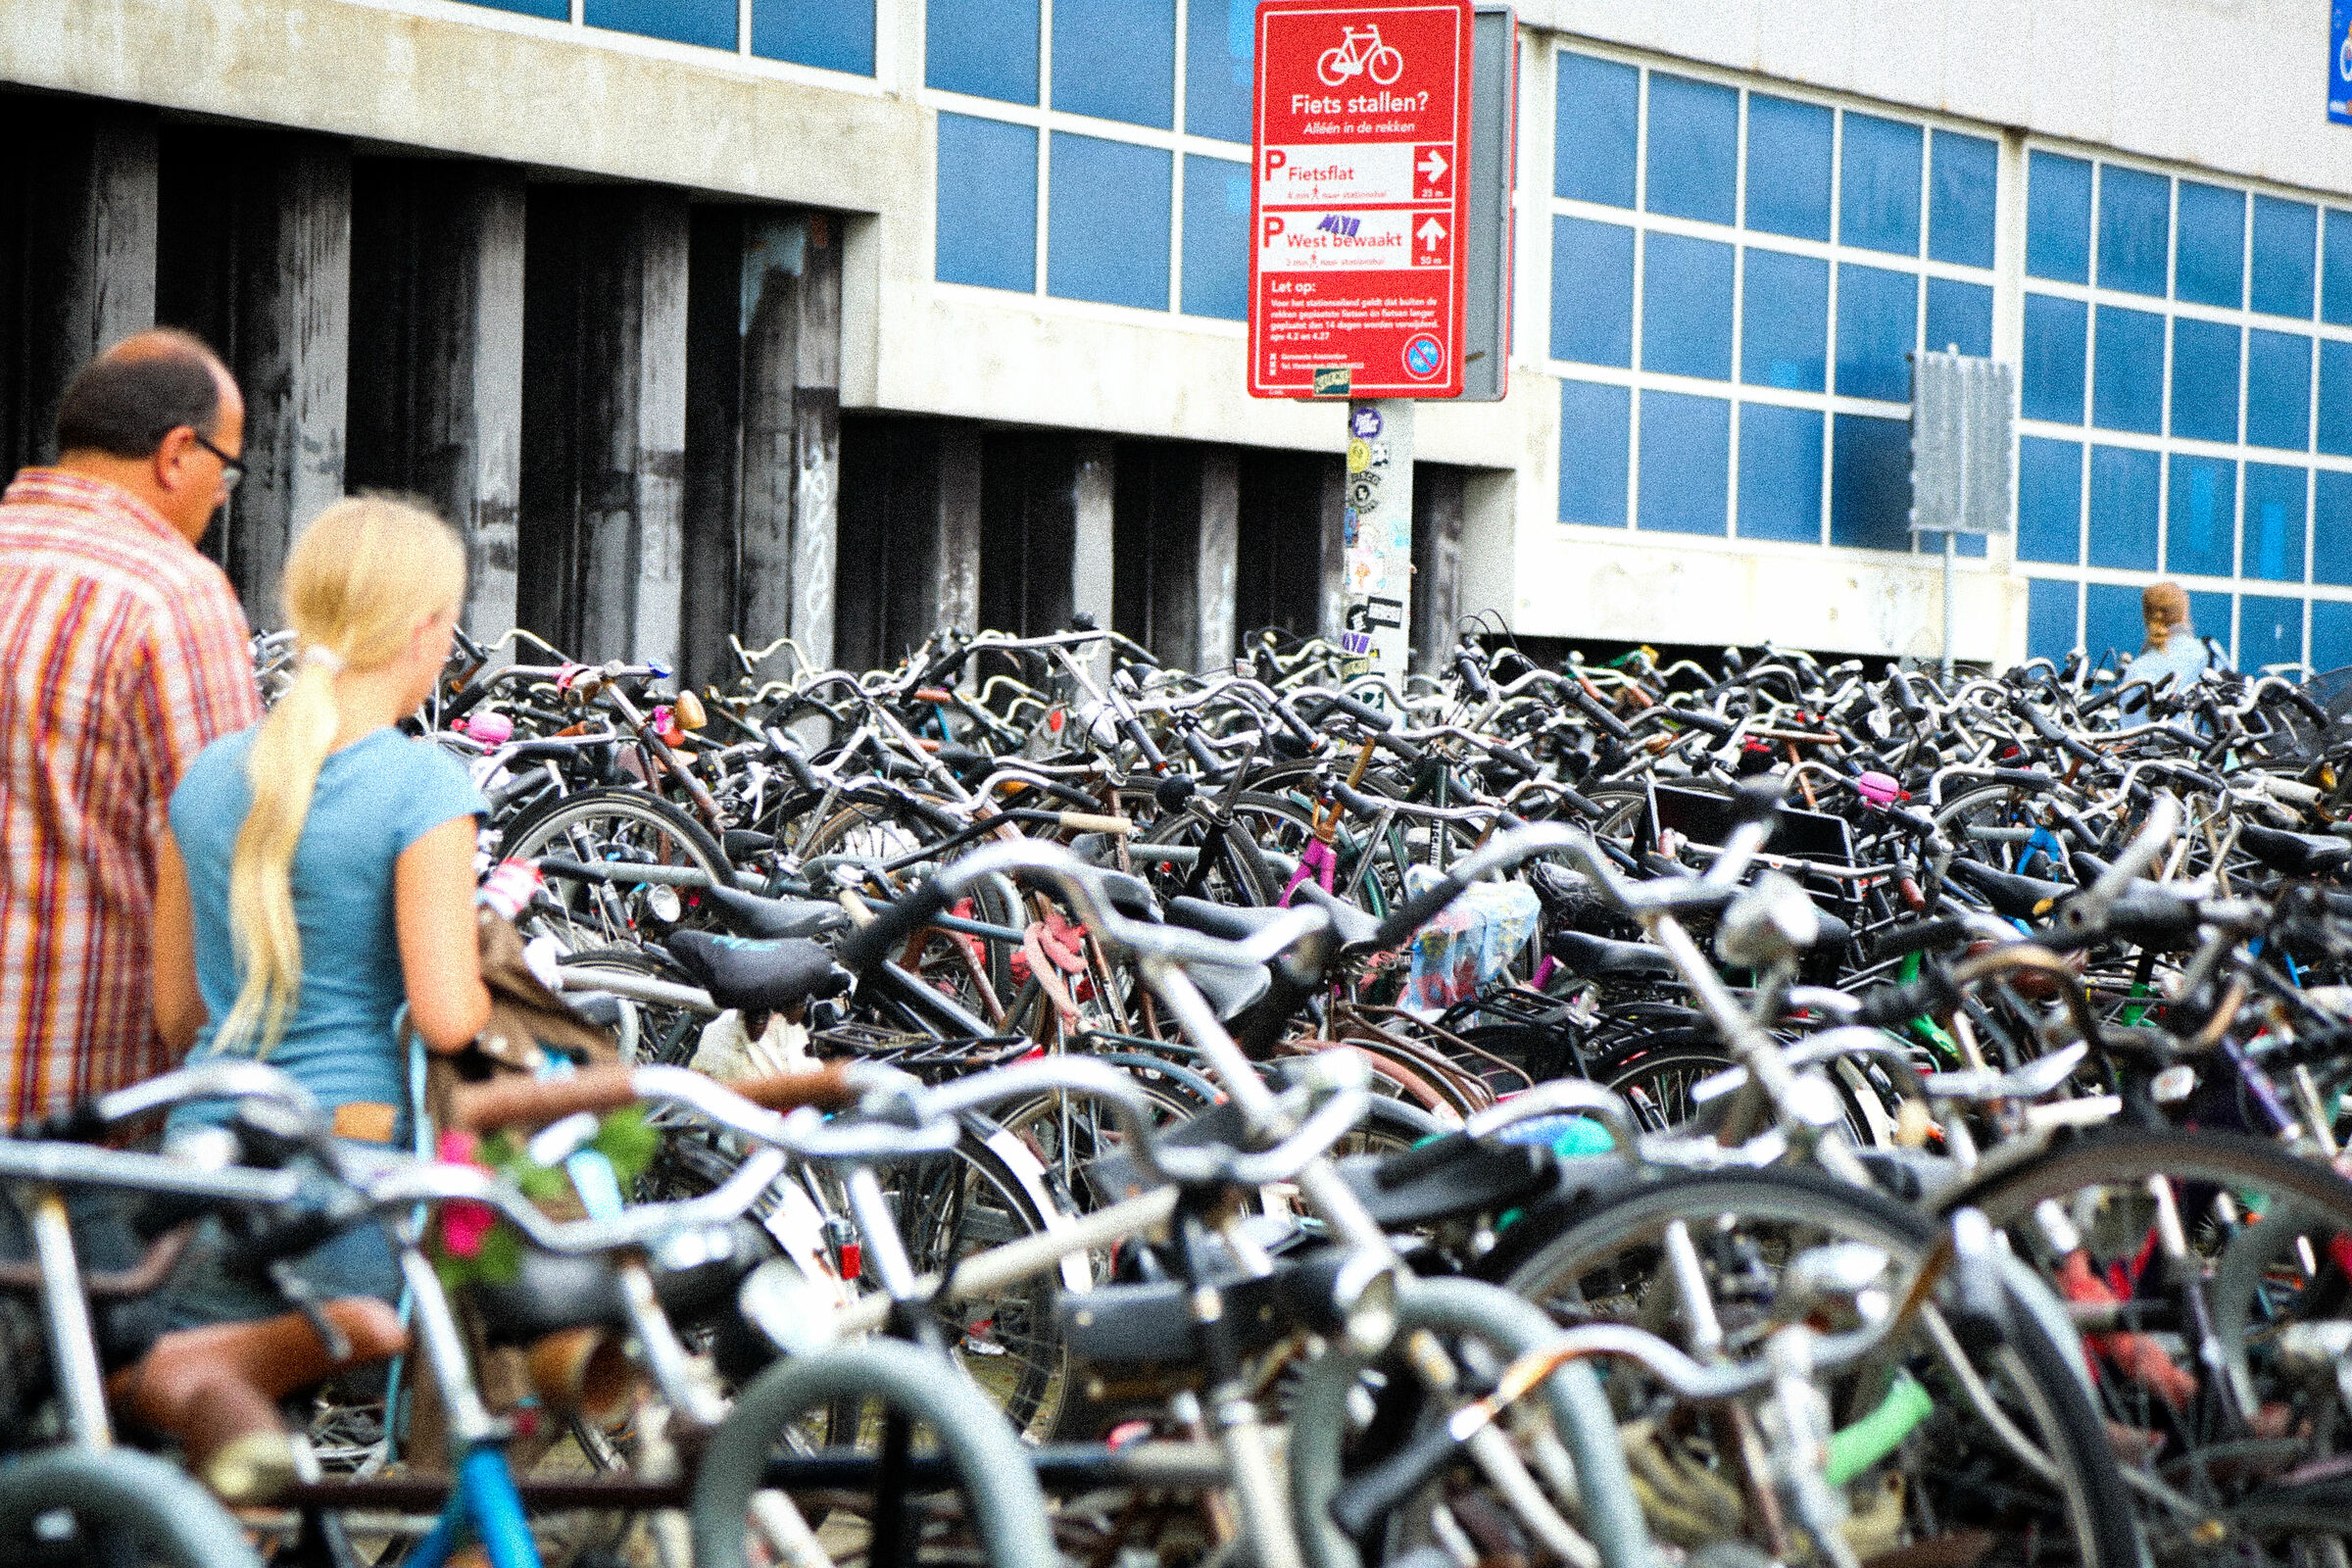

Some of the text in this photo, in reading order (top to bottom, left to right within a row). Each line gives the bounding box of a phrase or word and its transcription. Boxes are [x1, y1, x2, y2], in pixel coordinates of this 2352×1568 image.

[1291, 91, 1429, 115] Fiets stallen?
[1344, 122, 1354, 133] in
[1356, 121, 1372, 133] de
[1375, 120, 1415, 132] rekken
[1264, 150, 1286, 181] P
[1289, 165, 1354, 181] Fietsflat
[1263, 217, 1285, 248] P
[1287, 231, 1402, 248] West bewaakt
[1271, 280, 1316, 295] Let op:
